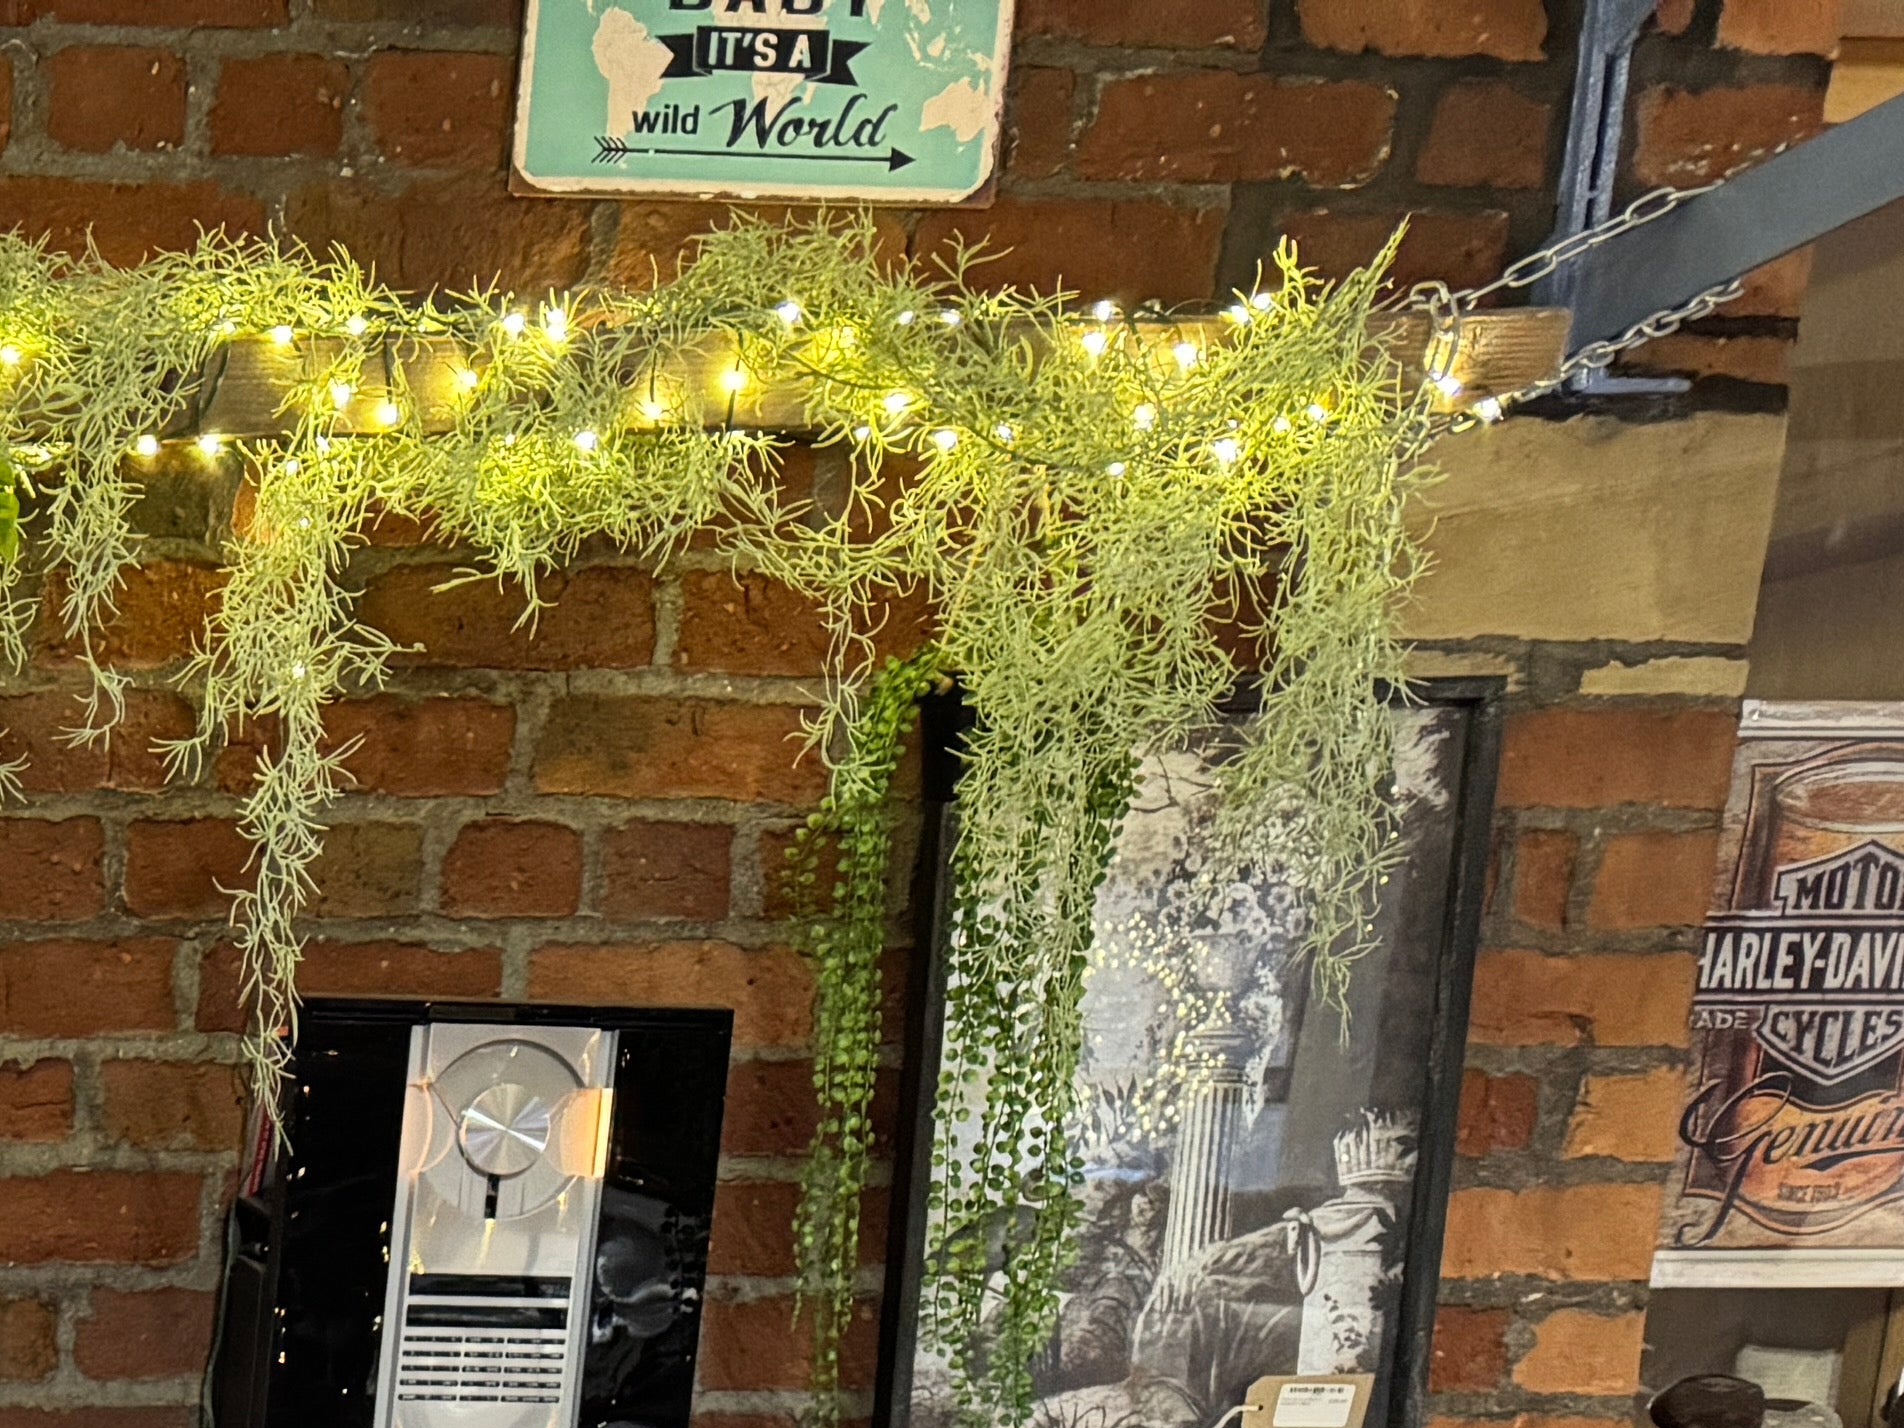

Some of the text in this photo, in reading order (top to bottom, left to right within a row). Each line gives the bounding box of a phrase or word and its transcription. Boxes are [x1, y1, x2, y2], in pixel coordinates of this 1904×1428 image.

[707, 31, 812, 68] IT'S A
[631, 93, 898, 149] wild World
[1794, 851, 1904, 911] MOTO
[1697, 931, 1904, 990] HARLEY-DAVI
[1689, 1010, 1749, 1030] ADE
[1769, 1009, 1904, 1064] CYCLES
